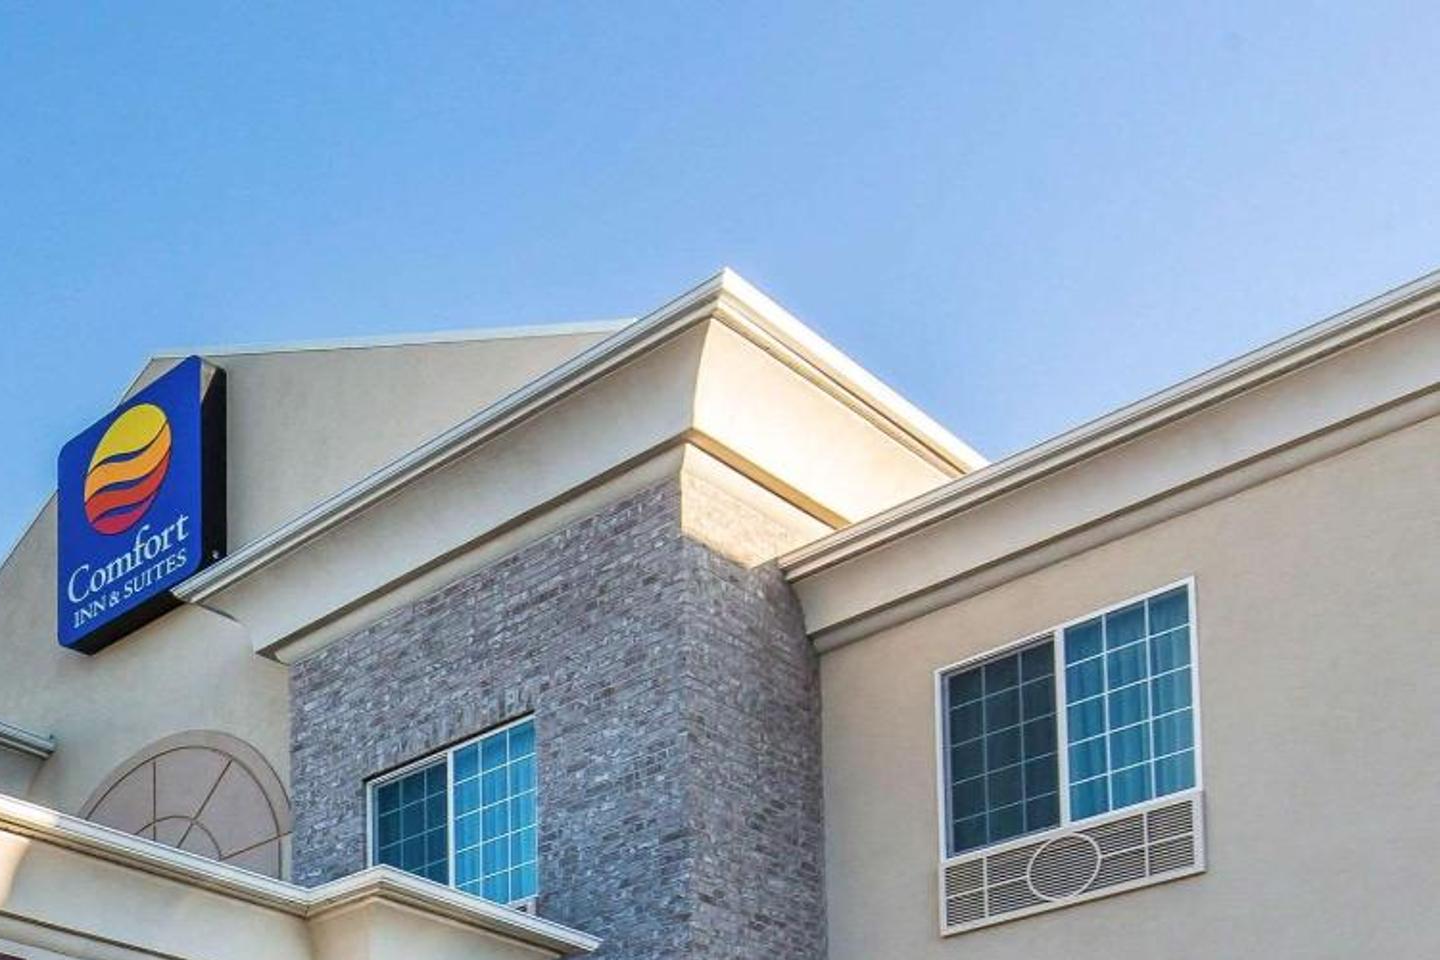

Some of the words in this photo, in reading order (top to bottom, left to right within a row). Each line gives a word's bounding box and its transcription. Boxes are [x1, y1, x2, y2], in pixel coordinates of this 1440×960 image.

[68, 514, 189, 603] Comfort
[73, 595, 107, 629] INN
[108, 590, 120, 608] &
[123, 548, 187, 599] SUITES
